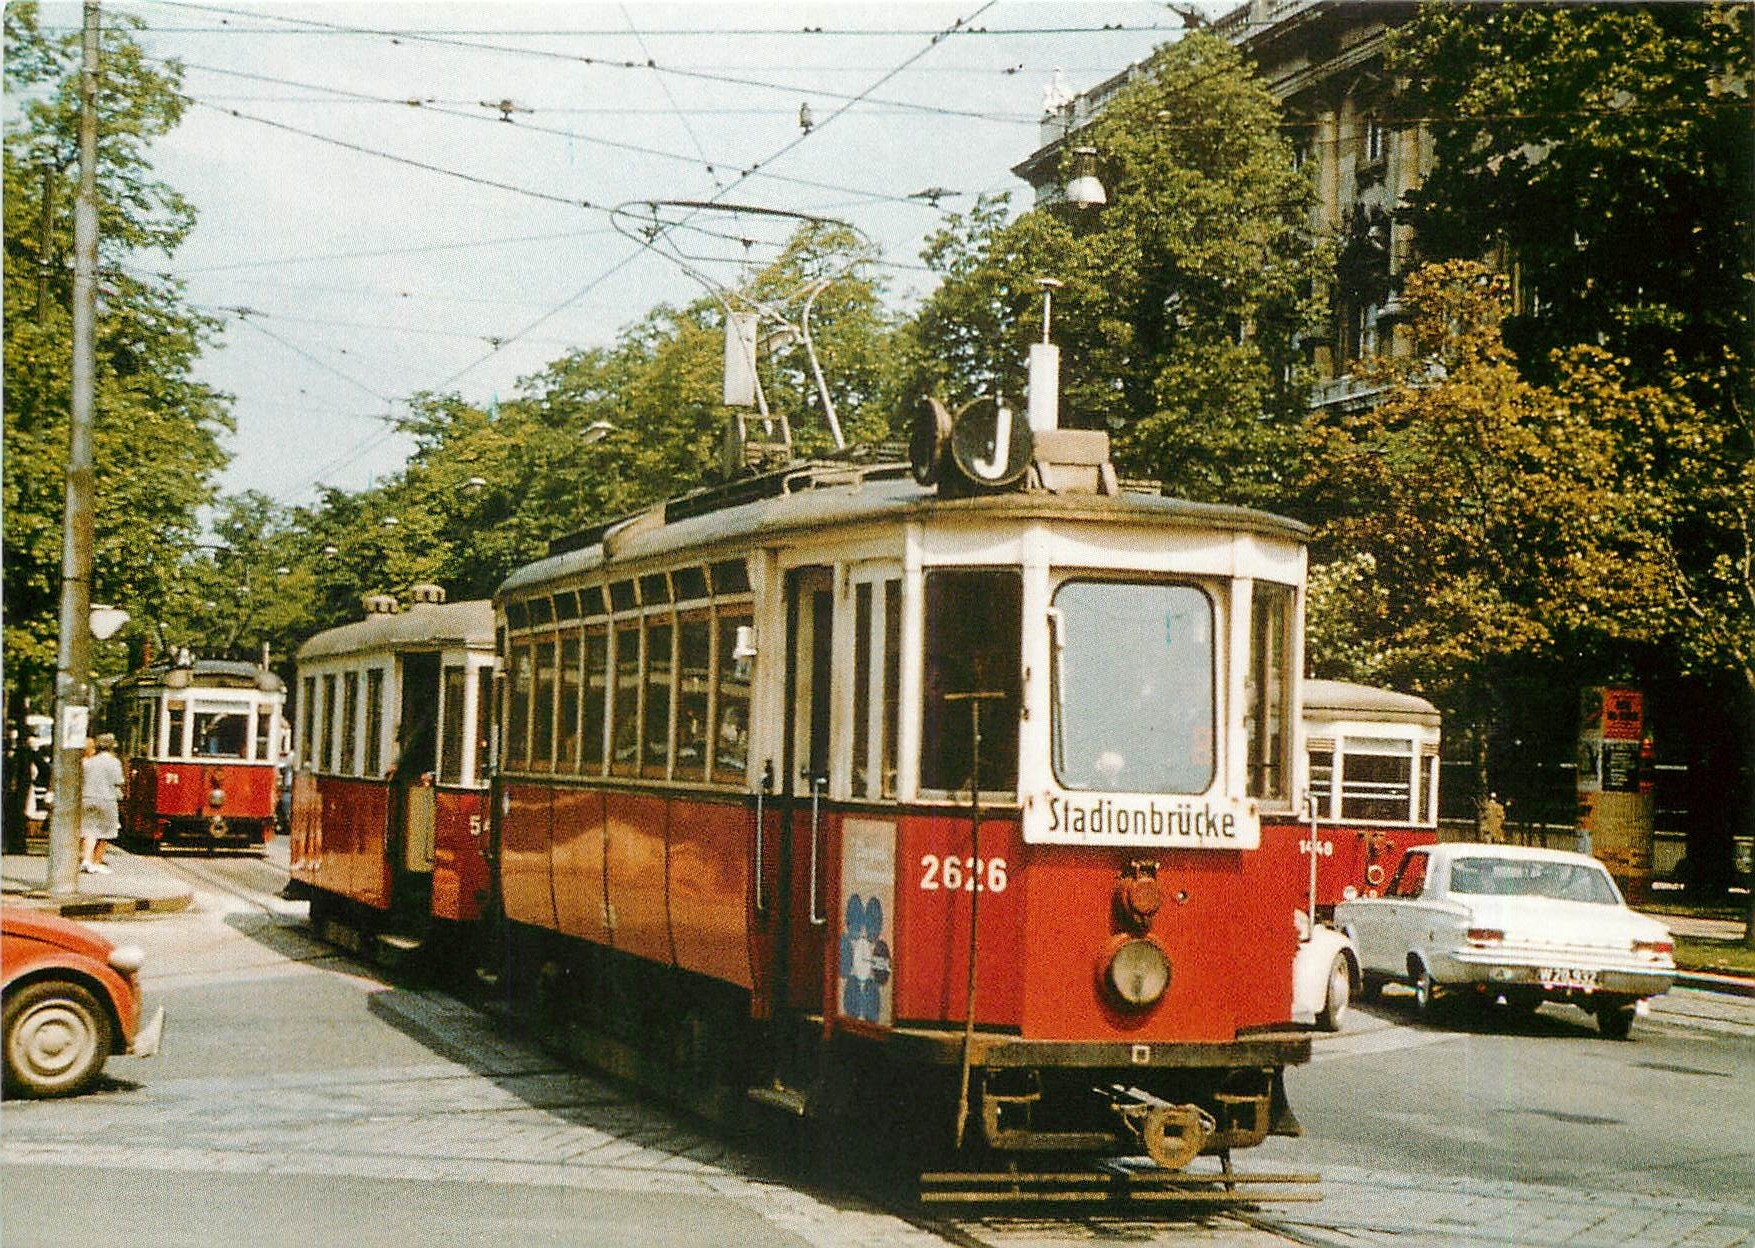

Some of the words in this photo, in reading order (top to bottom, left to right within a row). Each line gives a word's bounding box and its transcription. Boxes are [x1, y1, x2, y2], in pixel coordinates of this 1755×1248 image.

[973, 408, 1012, 479] J
[1049, 797, 1236, 838] Stadionbrücke
[920, 853, 1008, 893] 2626
